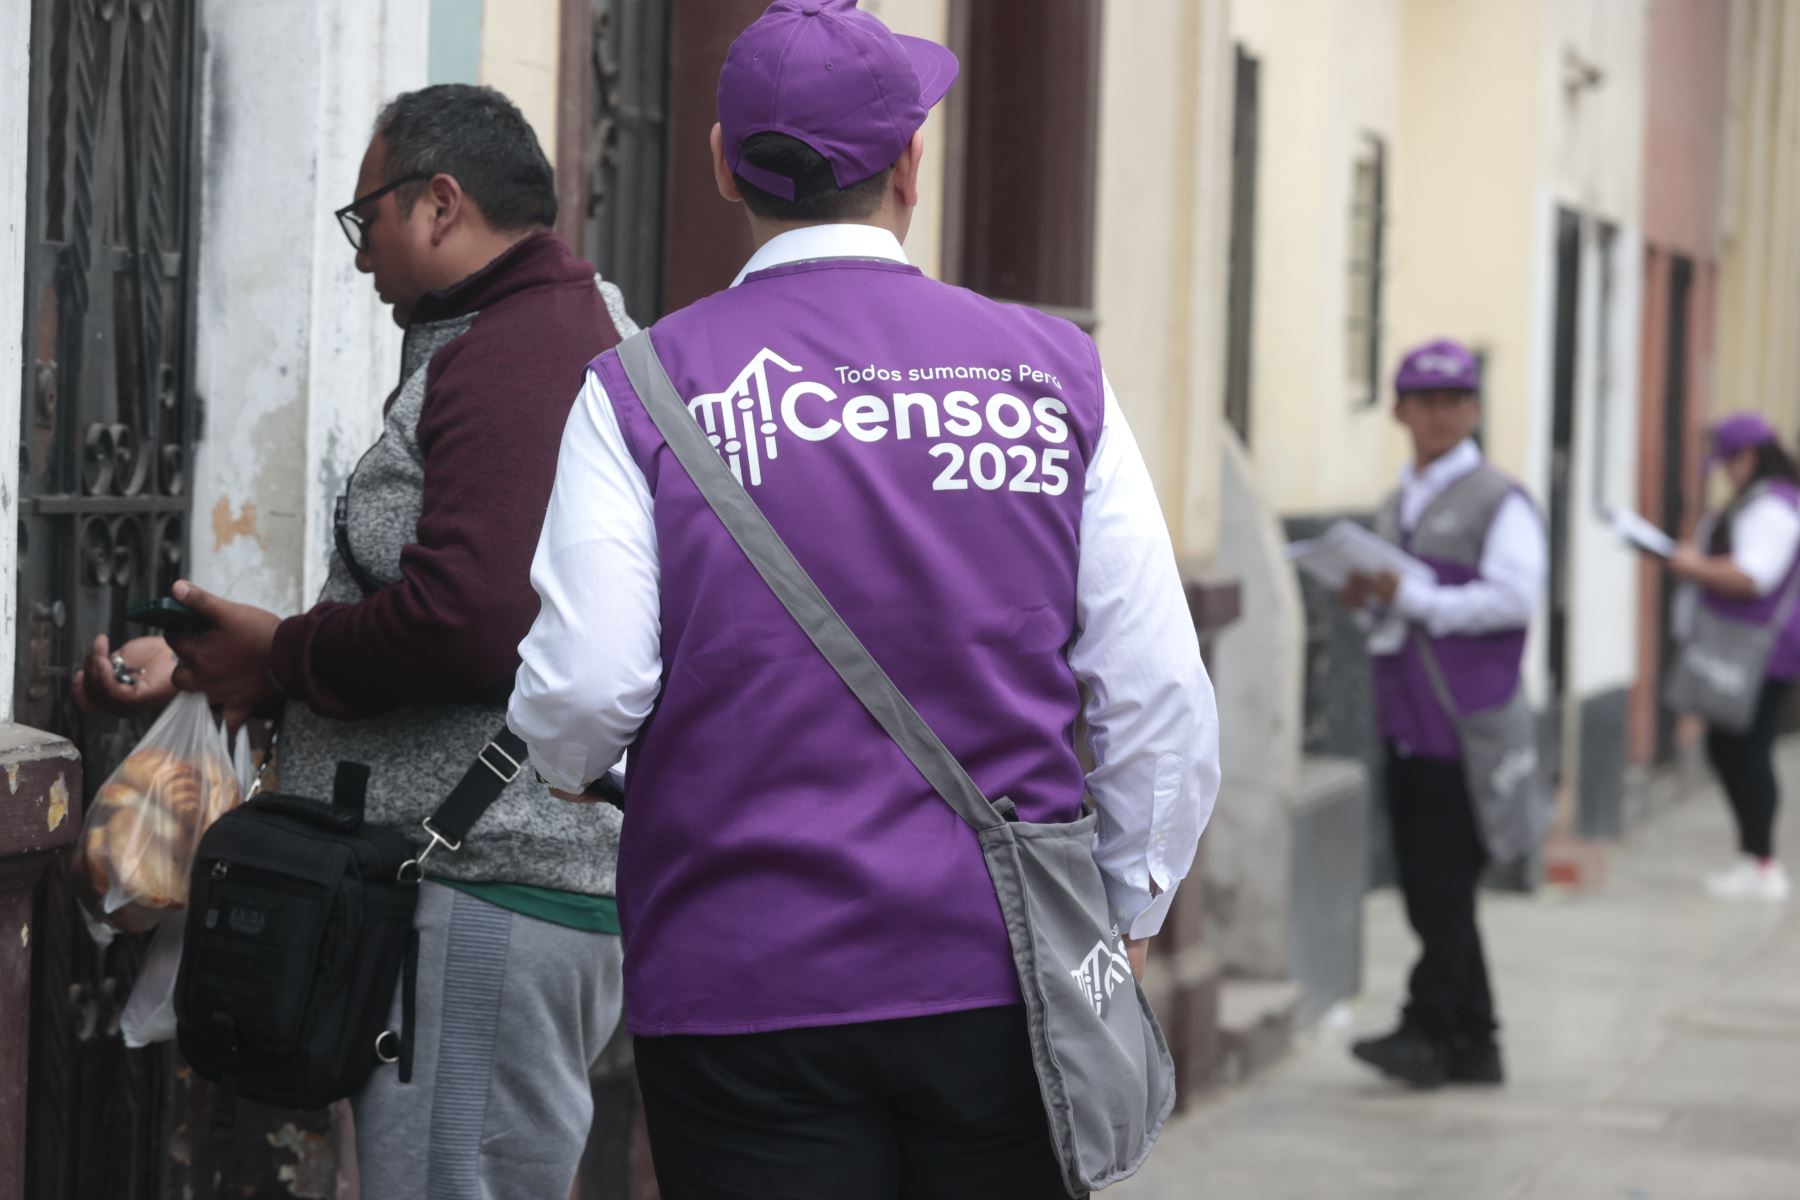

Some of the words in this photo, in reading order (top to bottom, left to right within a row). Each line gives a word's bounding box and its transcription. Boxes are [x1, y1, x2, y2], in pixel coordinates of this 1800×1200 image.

[834, 364, 902, 385] Todos
[908, 366, 1012, 382] sumamos
[780, 380, 1070, 444] Censos
[928, 442, 1070, 497] 2025
